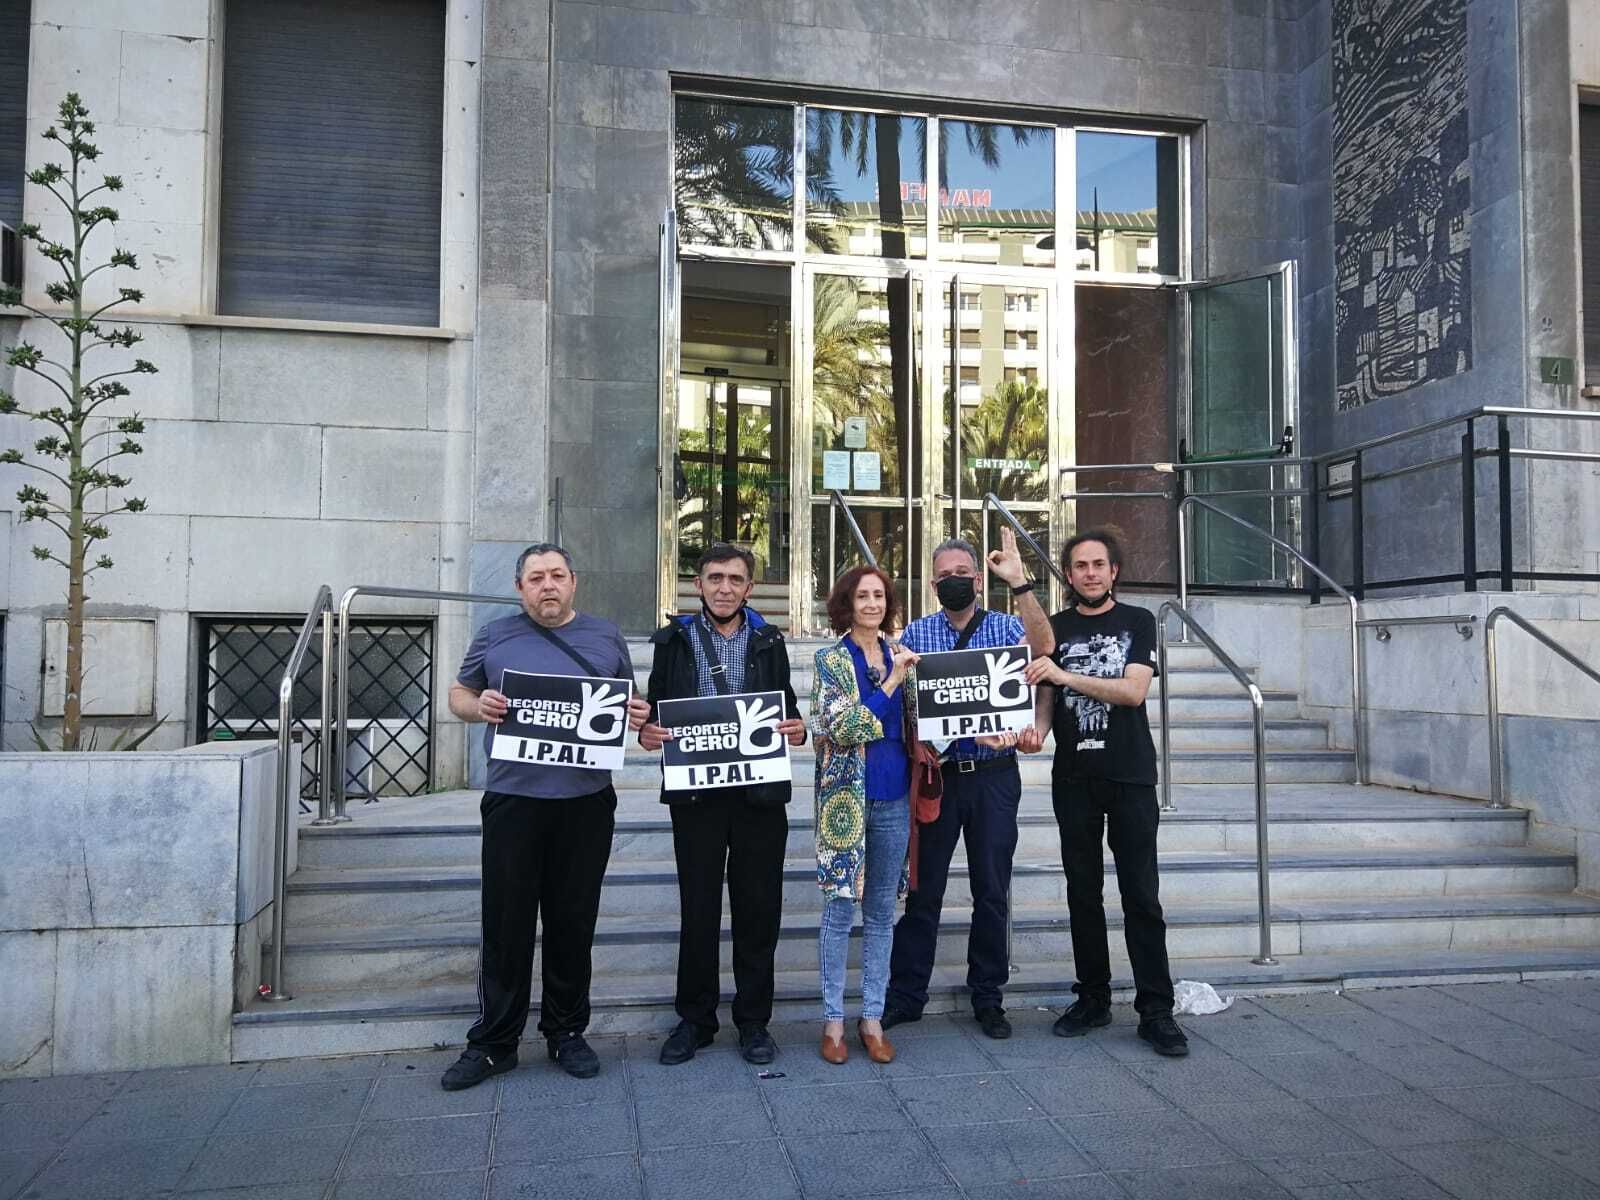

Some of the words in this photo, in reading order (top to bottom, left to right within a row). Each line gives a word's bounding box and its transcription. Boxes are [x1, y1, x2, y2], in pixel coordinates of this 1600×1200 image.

[1551, 360, 1562, 381] 4
[975, 458, 1032, 470] ENTRADA
[918, 675, 989, 691] RECORTES
[934, 685, 989, 705] CERO
[516, 708, 578, 730] CERO
[941, 714, 1013, 737] I.P.AL.
[518, 739, 597, 766] I.P.AL.
[679, 733, 738, 753] CERO
[688, 762, 765, 787] I.P.AL.
